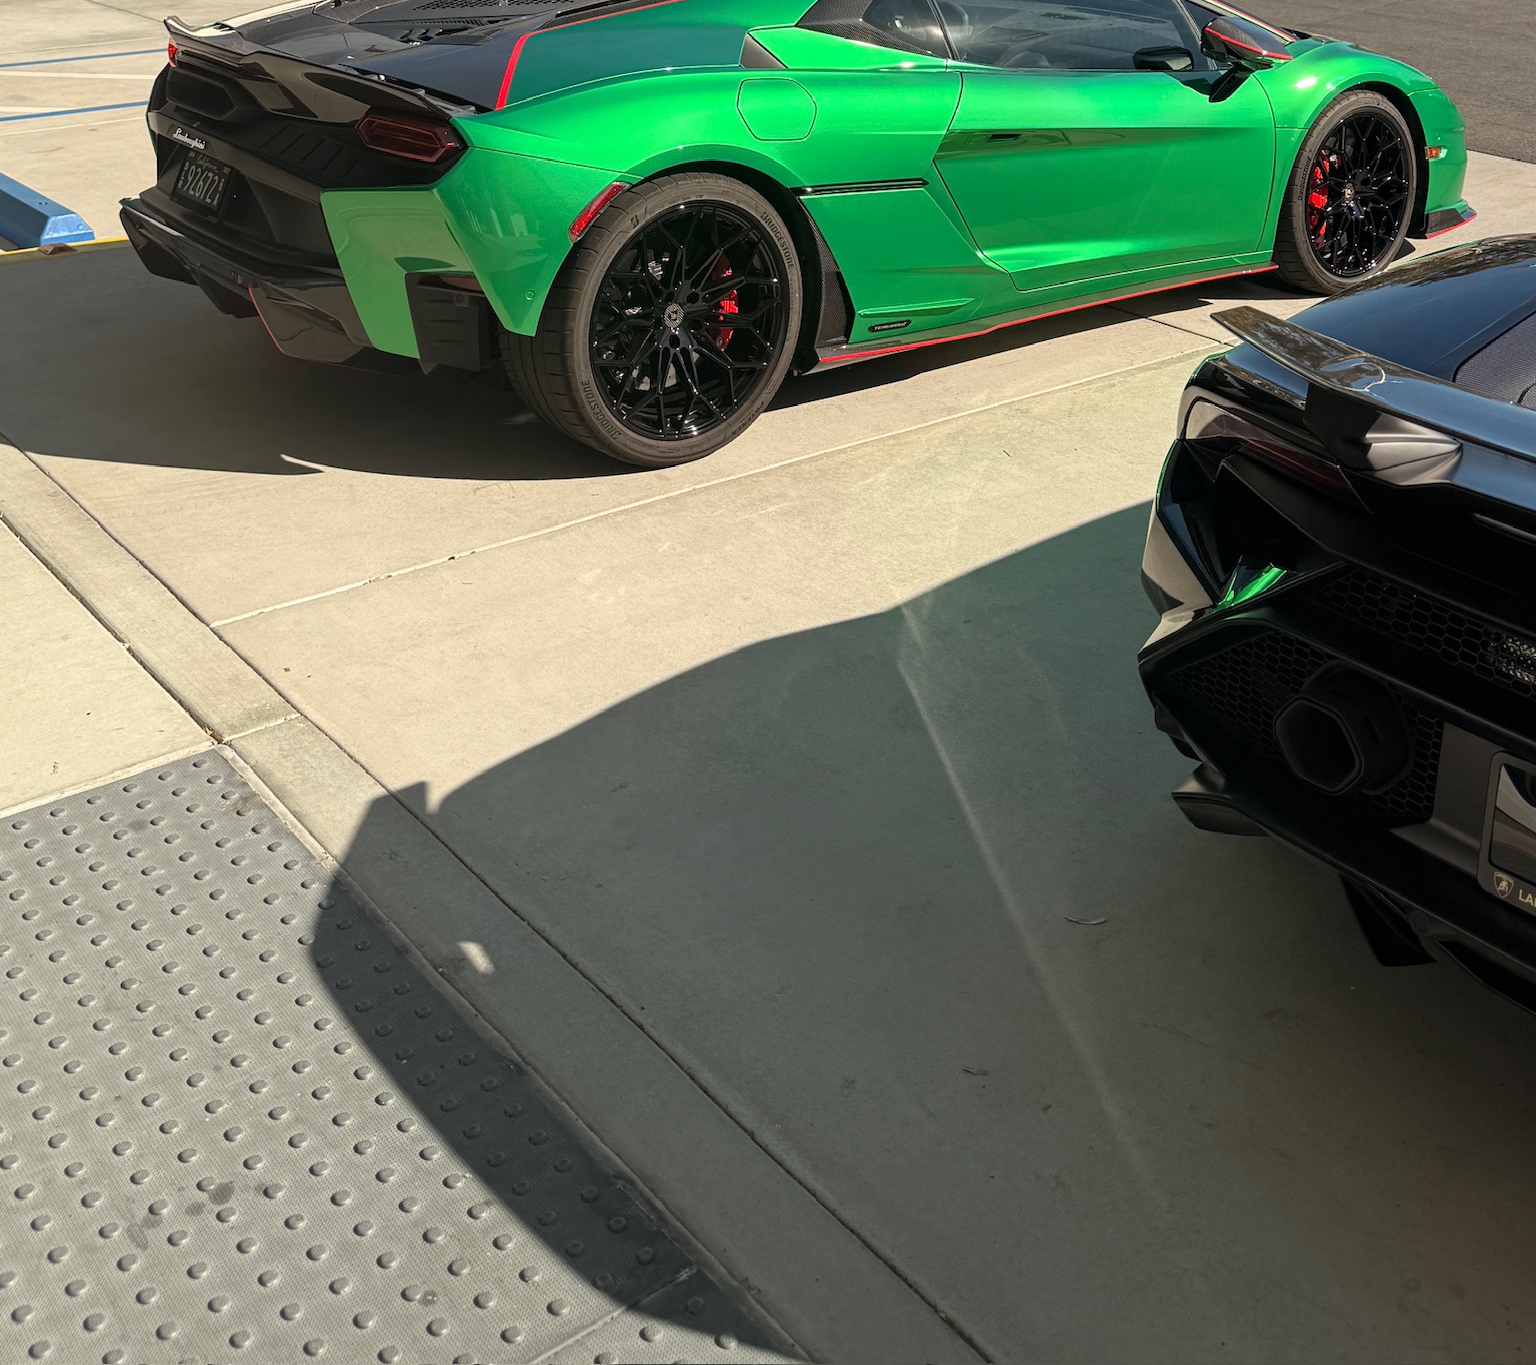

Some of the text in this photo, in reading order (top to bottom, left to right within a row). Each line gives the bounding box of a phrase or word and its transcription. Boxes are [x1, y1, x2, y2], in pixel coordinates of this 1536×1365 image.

[183, 165, 218, 203] 92672
[760, 211, 795, 269] BRIDGESTONE
[581, 380, 622, 440] BRIDGESTONE
[1518, 888, 1536, 907] LA
